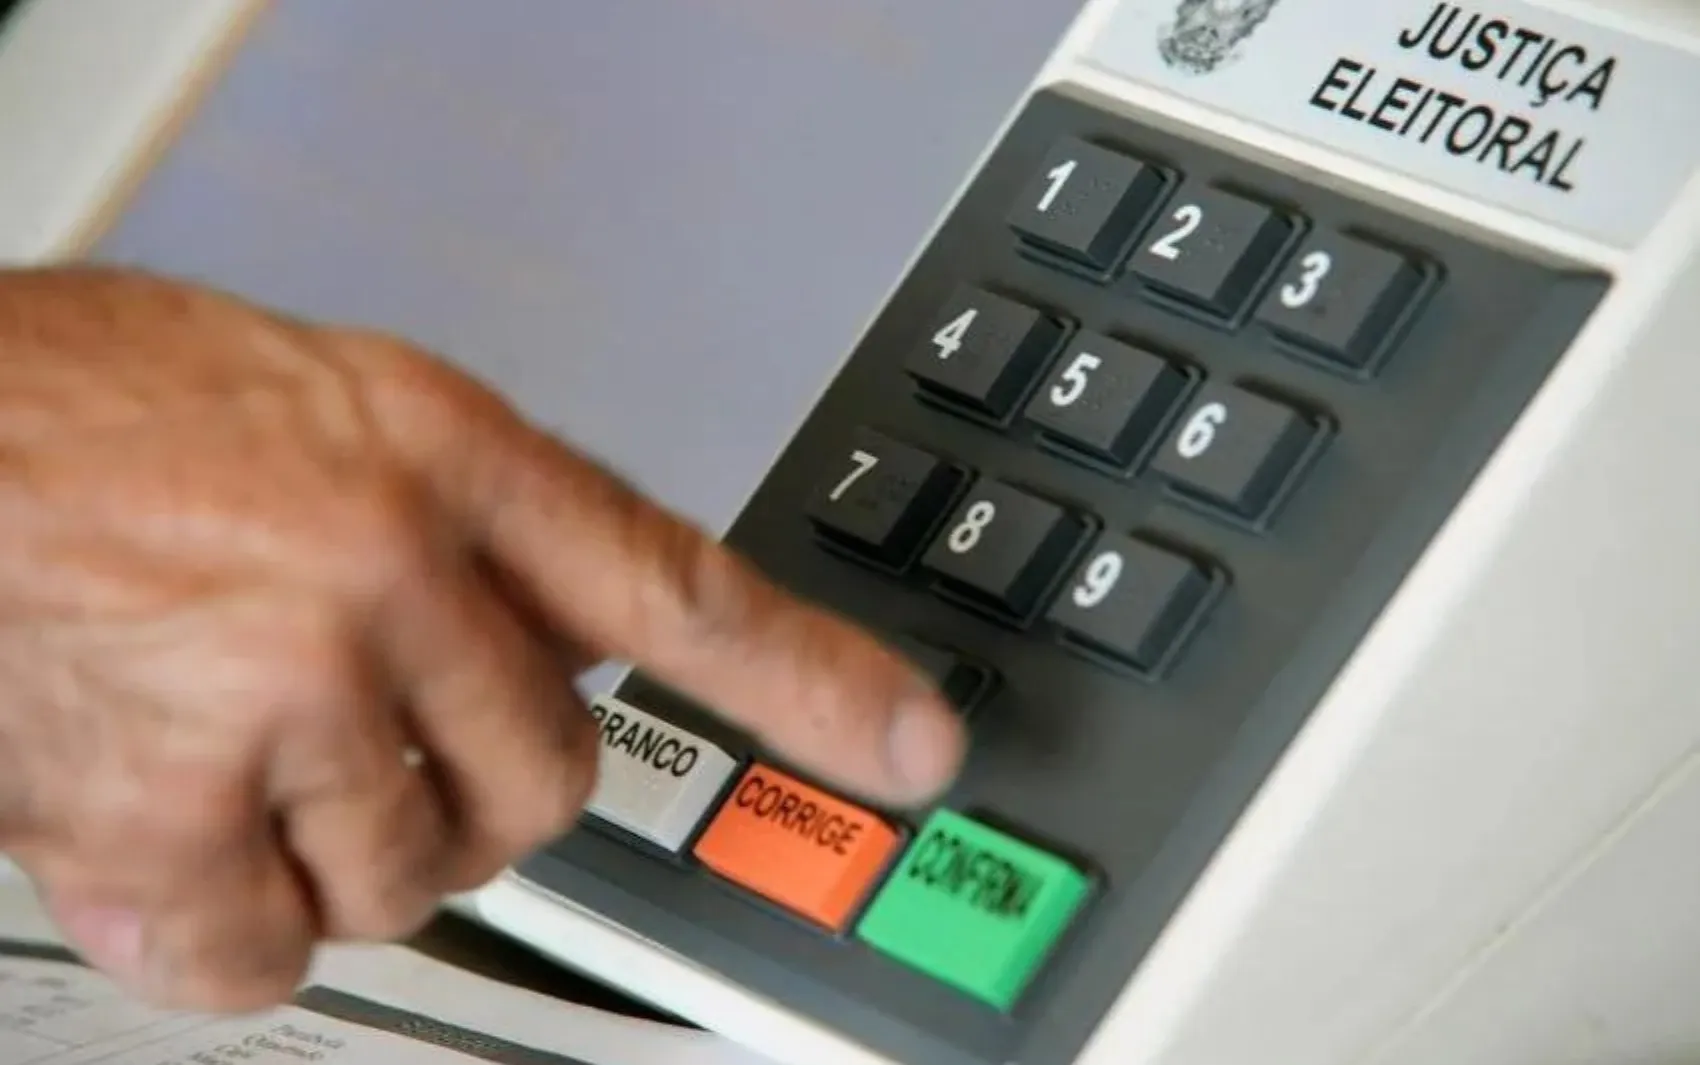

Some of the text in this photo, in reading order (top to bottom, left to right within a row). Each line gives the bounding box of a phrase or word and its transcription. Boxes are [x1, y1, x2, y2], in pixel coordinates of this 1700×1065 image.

[1398, 1, 1617, 110] JUSTIÇA
[1309, 57, 1584, 192] ELEITORAL
[1037, 160, 1077, 211] 1
[1149, 205, 1202, 260] 2
[1281, 252, 1330, 307] 3
[932, 308, 978, 359] 4
[1050, 353, 1103, 406] 5
[1177, 403, 1226, 458] 6
[830, 450, 879, 500] 7
[949, 501, 995, 553] 8
[1073, 552, 1123, 608] 9
[734, 776, 863, 856] CORRIGE
